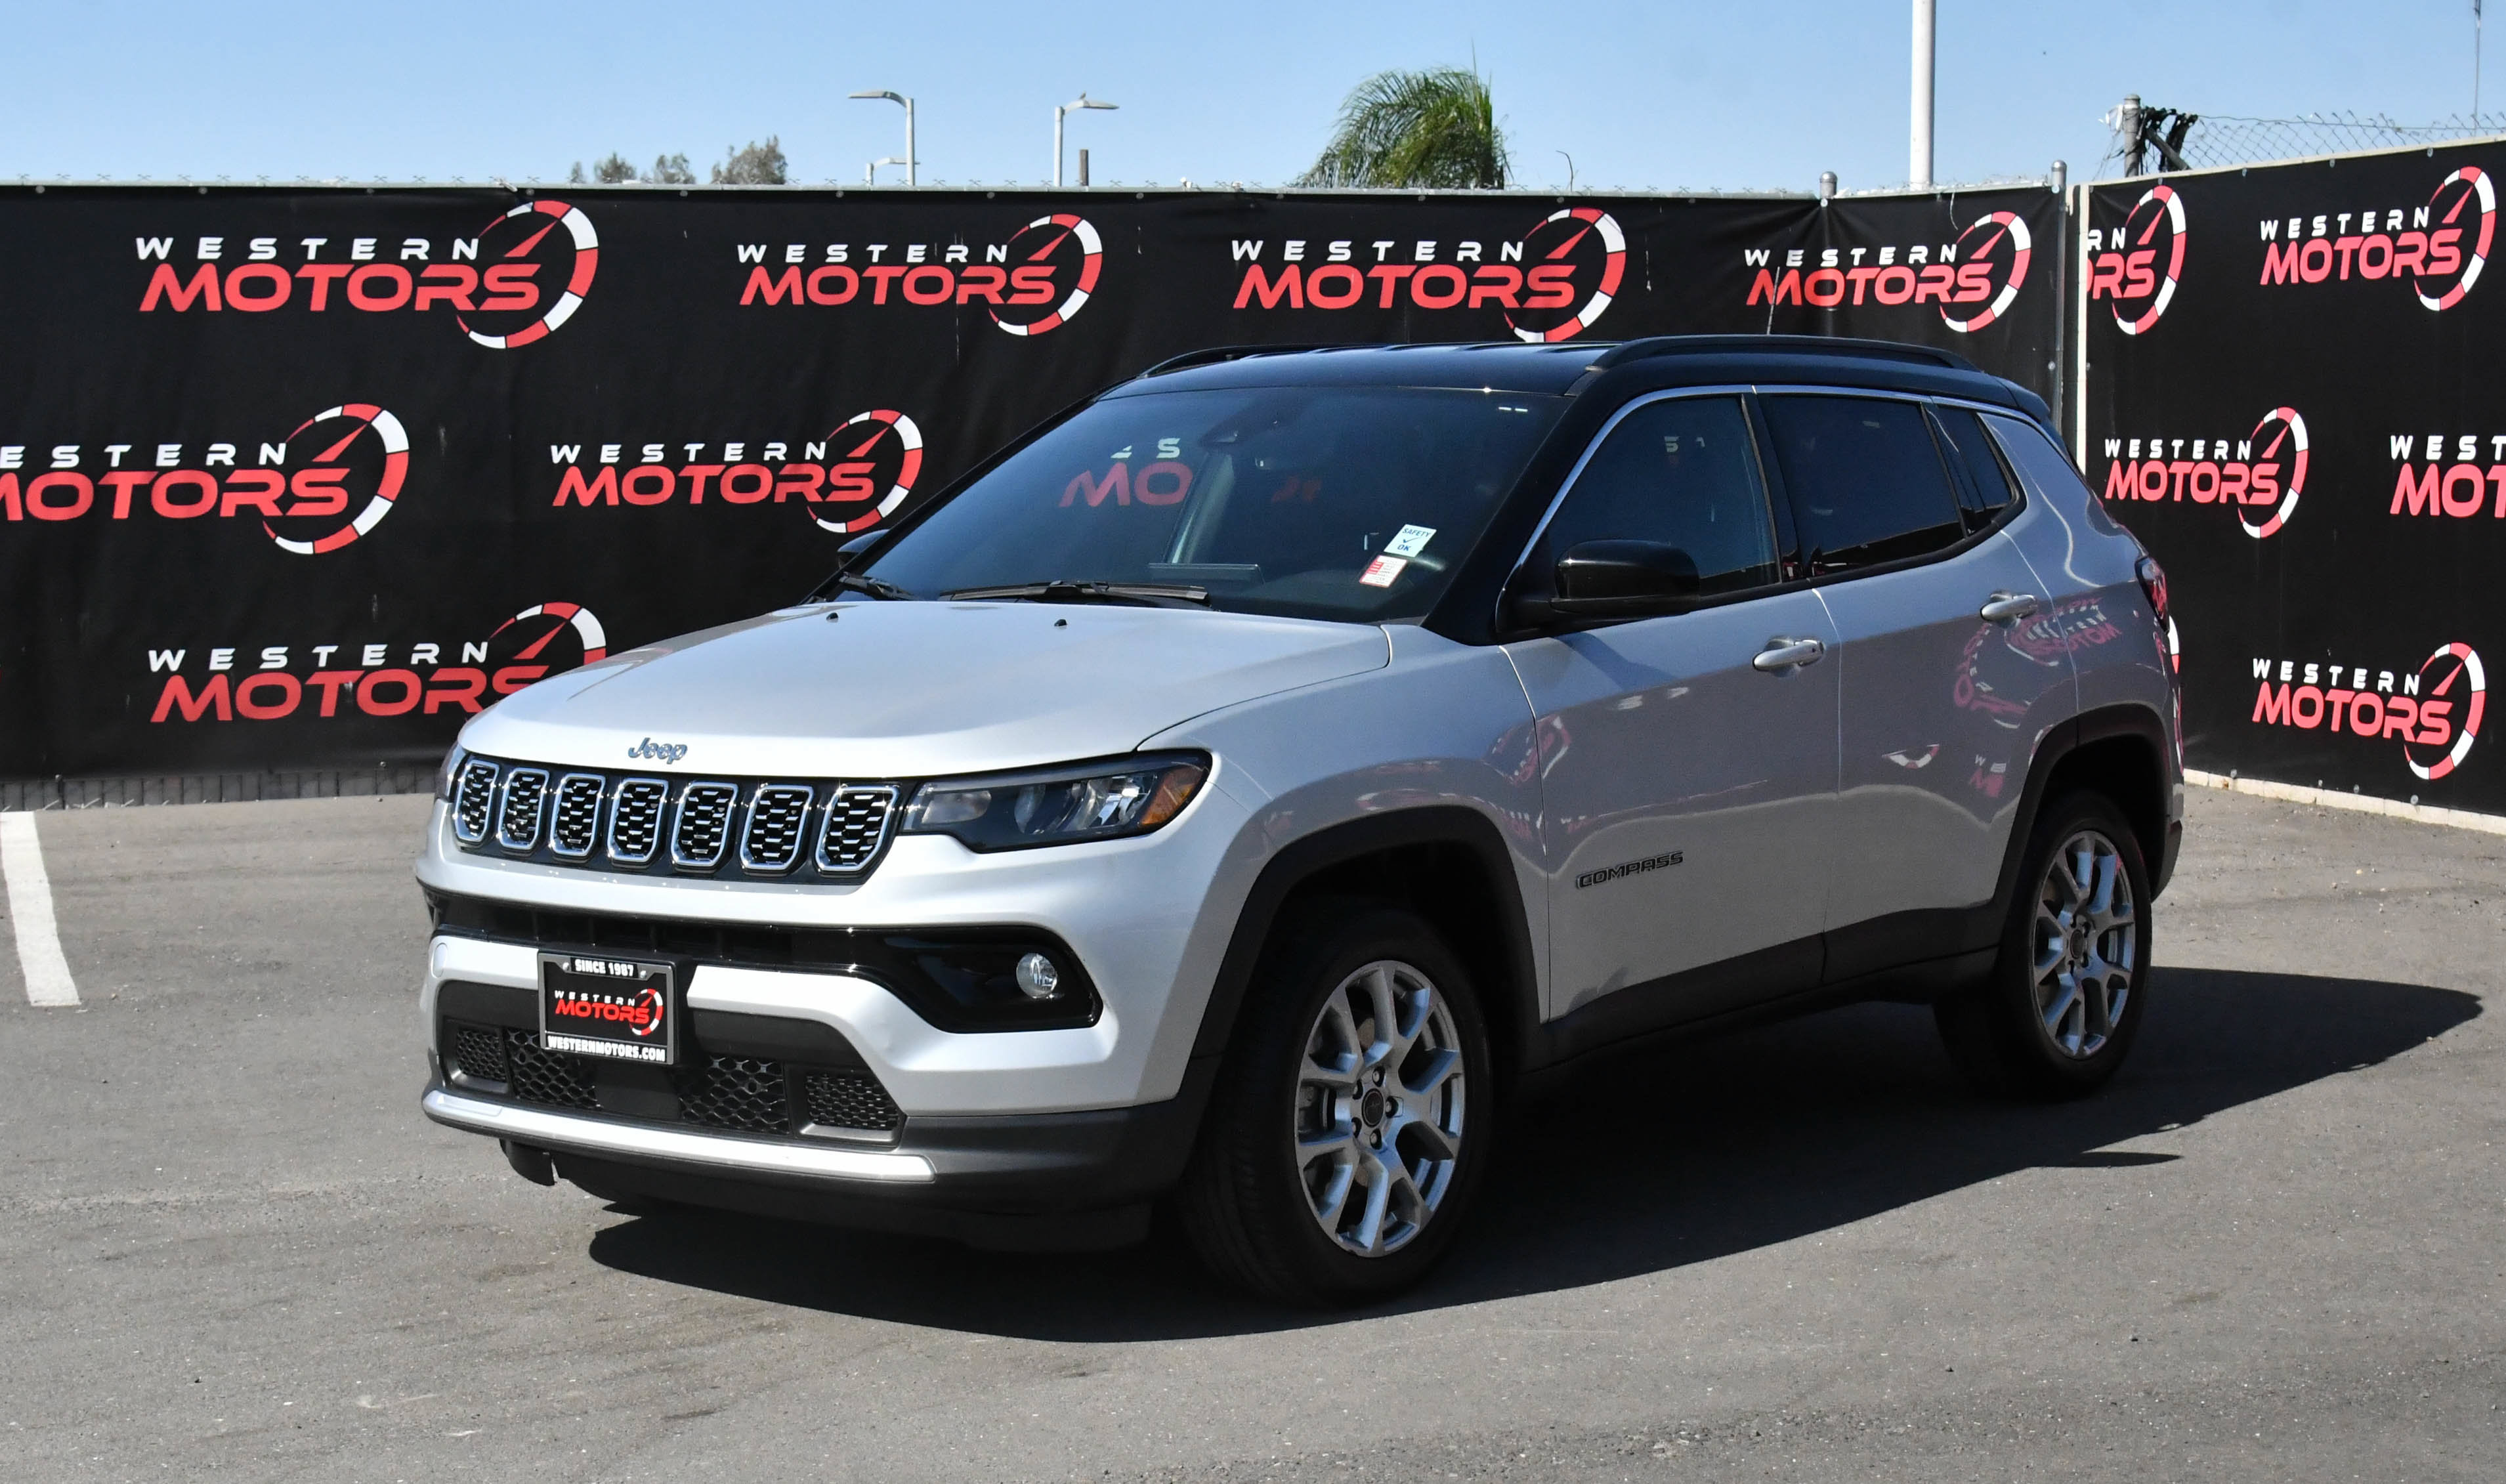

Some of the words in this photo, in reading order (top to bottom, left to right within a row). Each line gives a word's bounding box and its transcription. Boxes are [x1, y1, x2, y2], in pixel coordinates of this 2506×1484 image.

[2261, 206, 2430, 241] WESTERN
[135, 237, 479, 261] WESTERN
[737, 244, 1008, 263] WESTERN
[1231, 240, 1523, 262] WESTERN
[1744, 244, 1957, 267] WESTERN
[2259, 228, 2463, 286] MOTORS
[139, 263, 542, 312] MOTORS
[740, 265, 1057, 306] MOTORS
[1233, 263, 1577, 310] MOTORS
[1746, 263, 1994, 307] MOTORS
[550, 441, 826, 464] WESTERN
[2104, 438, 2251, 461] WESTERN
[552, 462, 876, 507] MOTORS
[2104, 459, 2281, 505] MOTORS
[1402, 528, 1432, 538] SAFETY
[1397, 543, 1411, 552] OK
[148, 641, 488, 673] WESTERN
[2253, 658, 2420, 696] WESTERN
[2252, 680, 2453, 746] MOTORS
[627, 737, 689, 765] Jeep
[1575, 851, 1684, 889] COMPASS
[574, 958, 606, 974] SINCE
[608, 962, 634, 977] 1987
[554, 990, 635, 1007] WESTERN
[555, 998, 650, 1025] MOTORS
[547, 1035, 666, 1063] WESTERNMOTORS.COM
